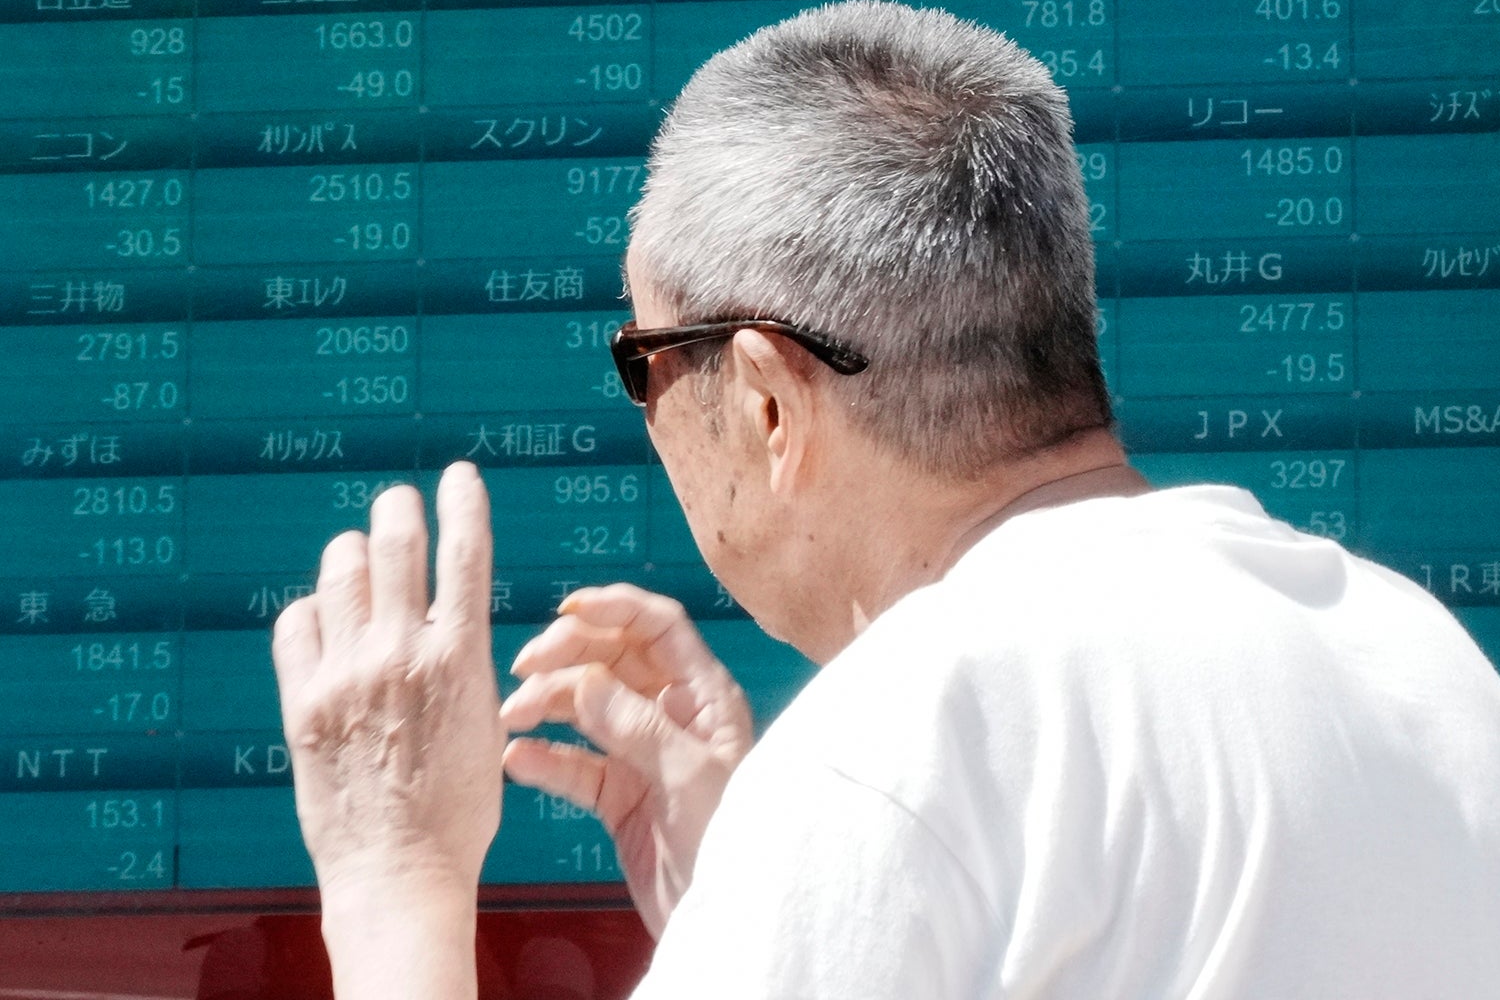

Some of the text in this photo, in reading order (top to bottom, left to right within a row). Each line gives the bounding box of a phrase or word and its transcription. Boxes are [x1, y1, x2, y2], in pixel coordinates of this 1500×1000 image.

[130, 28, 185, 54] 928
[315, 21, 412, 49] 1663.0
[569, 14, 641, 42] 4502
[1263, 43, 1339, 70] -13.4
[1189, 98, 1283, 126] リコー
[32, 132, 127, 161] ニコン
[471, 117, 603, 150] スクリン
[1241, 148, 1342, 174] 1485.0
[84, 180, 181, 207] 1427.0
[310, 173, 410, 201] 2510.5
[1186, 252, 1282, 284] 丸井G
[30, 281, 125, 314] 三井物
[487, 269, 584, 302] 住友商
[1240, 304, 1344, 333] 2477.5
[77, 332, 179, 361] 2791.5
[317, 326, 408, 354] 20650
[23, 436, 120, 466] みずほ
[466, 424, 595, 457] 大和証G
[1271, 461, 1346, 488] 3297
[74, 486, 174, 515] 2810.5
[554, 475, 638, 503] 995.6
[72, 642, 171, 671] 1841.5
[86, 801, 163, 828] 153.1
